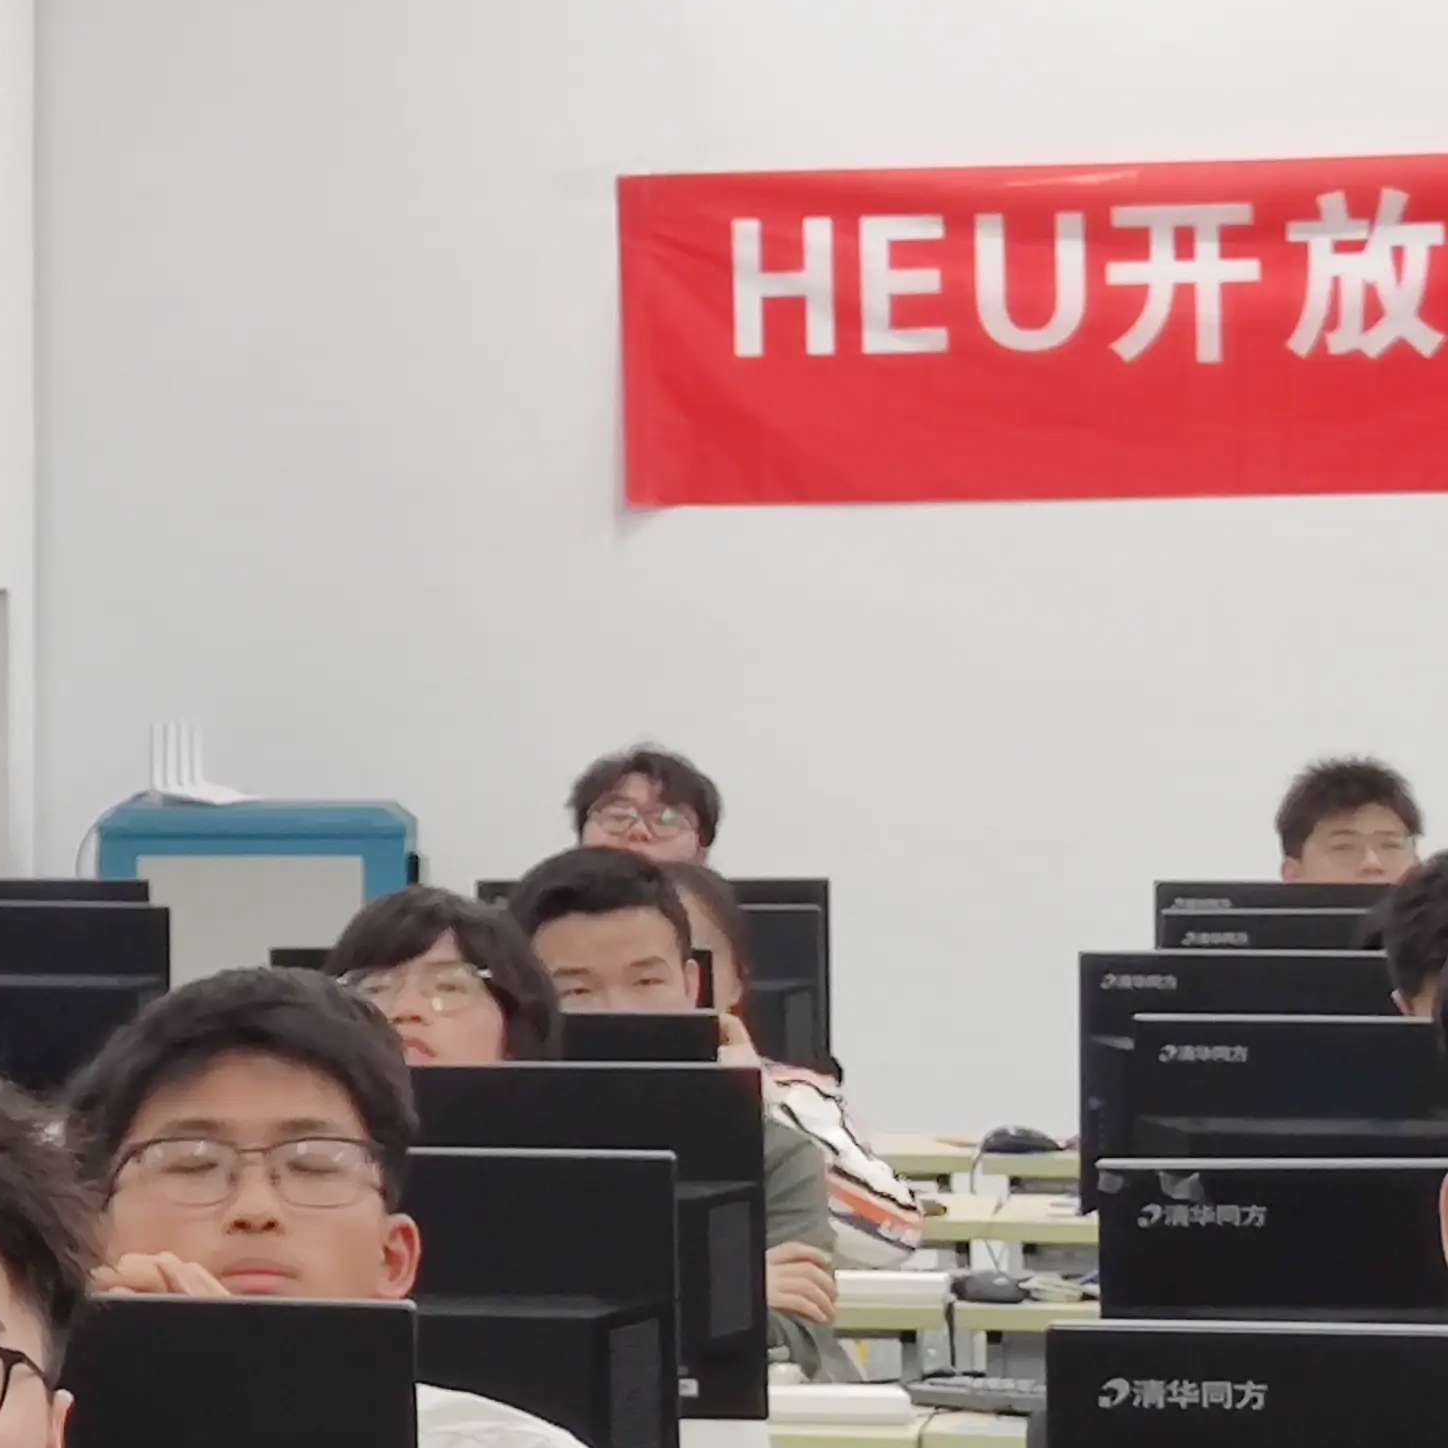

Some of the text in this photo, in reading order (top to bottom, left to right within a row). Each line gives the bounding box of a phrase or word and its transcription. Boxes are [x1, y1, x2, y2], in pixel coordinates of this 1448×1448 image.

[729, 187, 1445, 364] HEU开放
[1164, 1204, 1268, 1228] 清华同方
[1132, 1378, 1270, 1411] 清华同方
